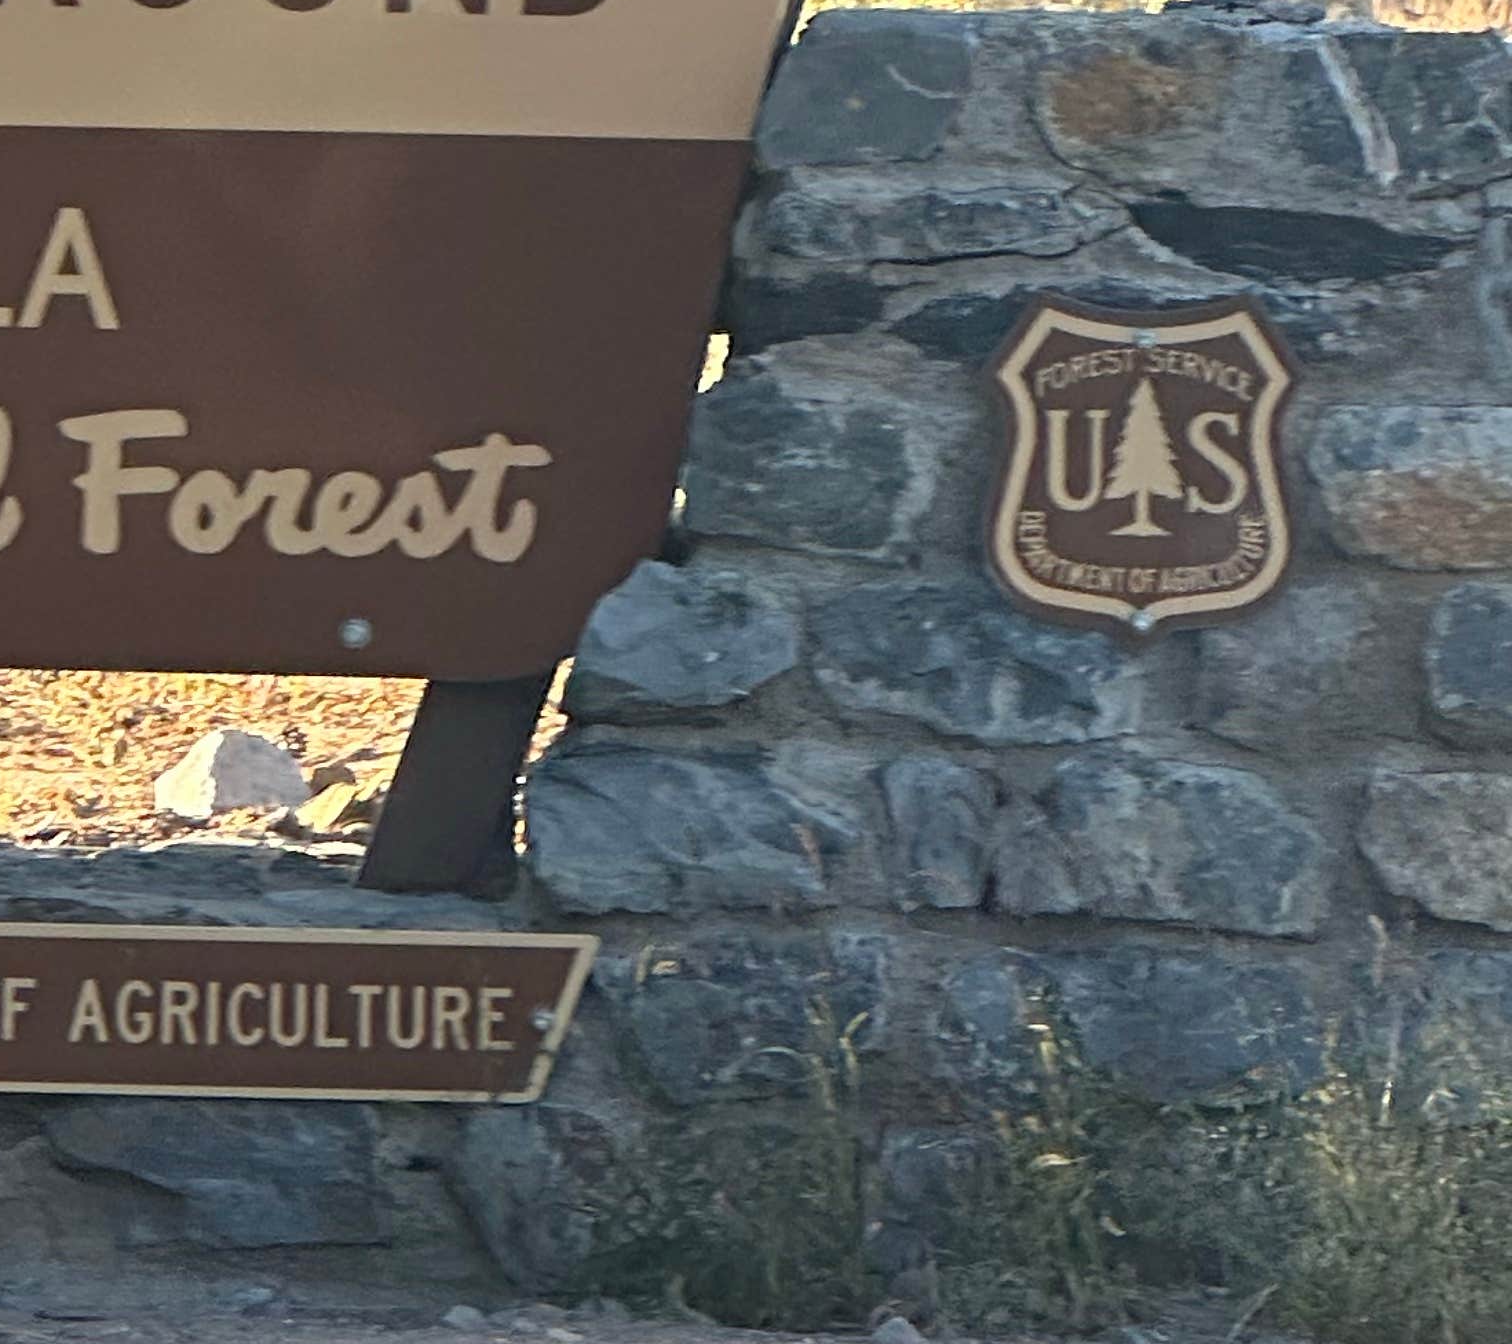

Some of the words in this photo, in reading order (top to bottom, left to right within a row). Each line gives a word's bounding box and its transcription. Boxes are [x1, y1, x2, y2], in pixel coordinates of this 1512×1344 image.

[1035, 348, 1135, 398] FOREST
[1143, 347, 1254, 402] SERVICE
[57, 409, 552, 563] Forest
[68, 978, 513, 1051] AGRICULTURE
